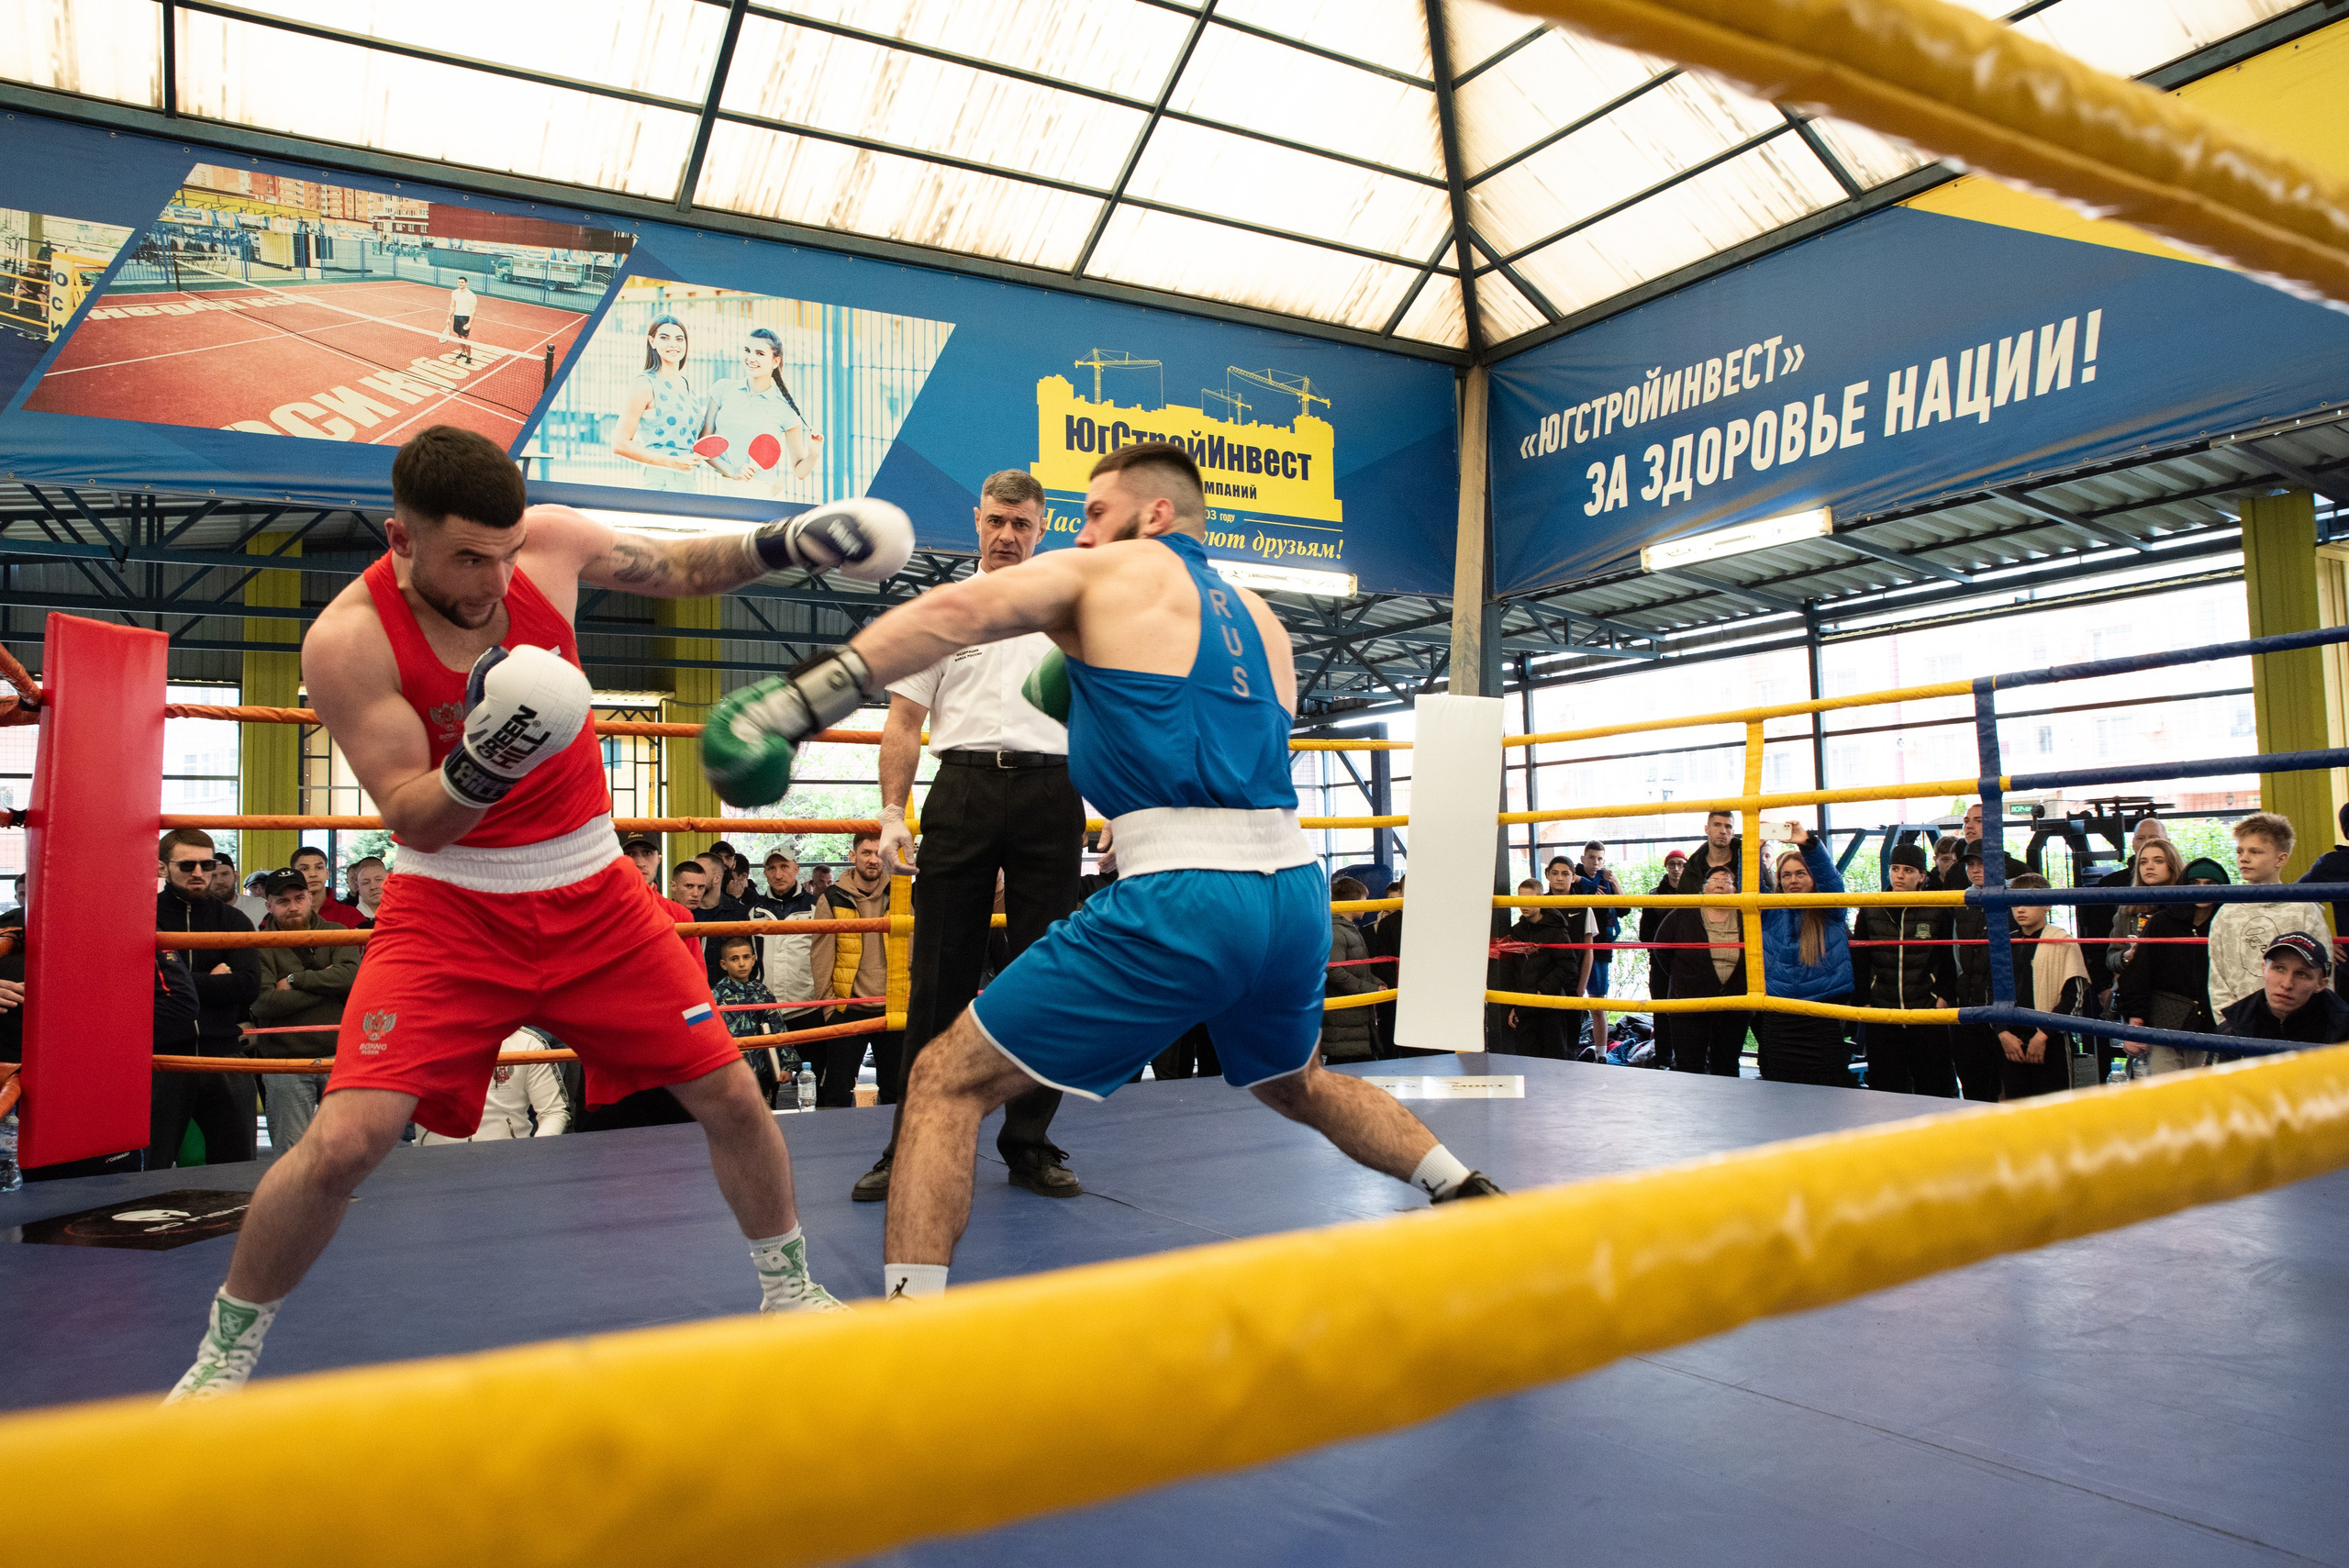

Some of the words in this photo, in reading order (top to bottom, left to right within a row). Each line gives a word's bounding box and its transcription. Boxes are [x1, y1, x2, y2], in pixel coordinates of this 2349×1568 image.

[83, 298, 249, 321] Кубан
[219, 385, 401, 442] СИ
[356, 346, 510, 406] Кубан
[1520, 335, 1805, 460] «ЮГСТРОЙИНВЕСТ»
[1584, 454, 1629, 517] ЗА
[1641, 380, 1869, 507] ЗДОРОВЬЕ
[1884, 308, 2102, 437] НАЦИИ!
[1204, 481, 1257, 500] МПАНИЙ
[1205, 509, 1217, 520] 03
[1220, 513, 1235, 524] году
[1252, 529, 1343, 560] друзьям!
[1208, 589, 1250, 697] RUS
[476, 705, 538, 760] GREEN
[489, 731, 551, 770] HILL
